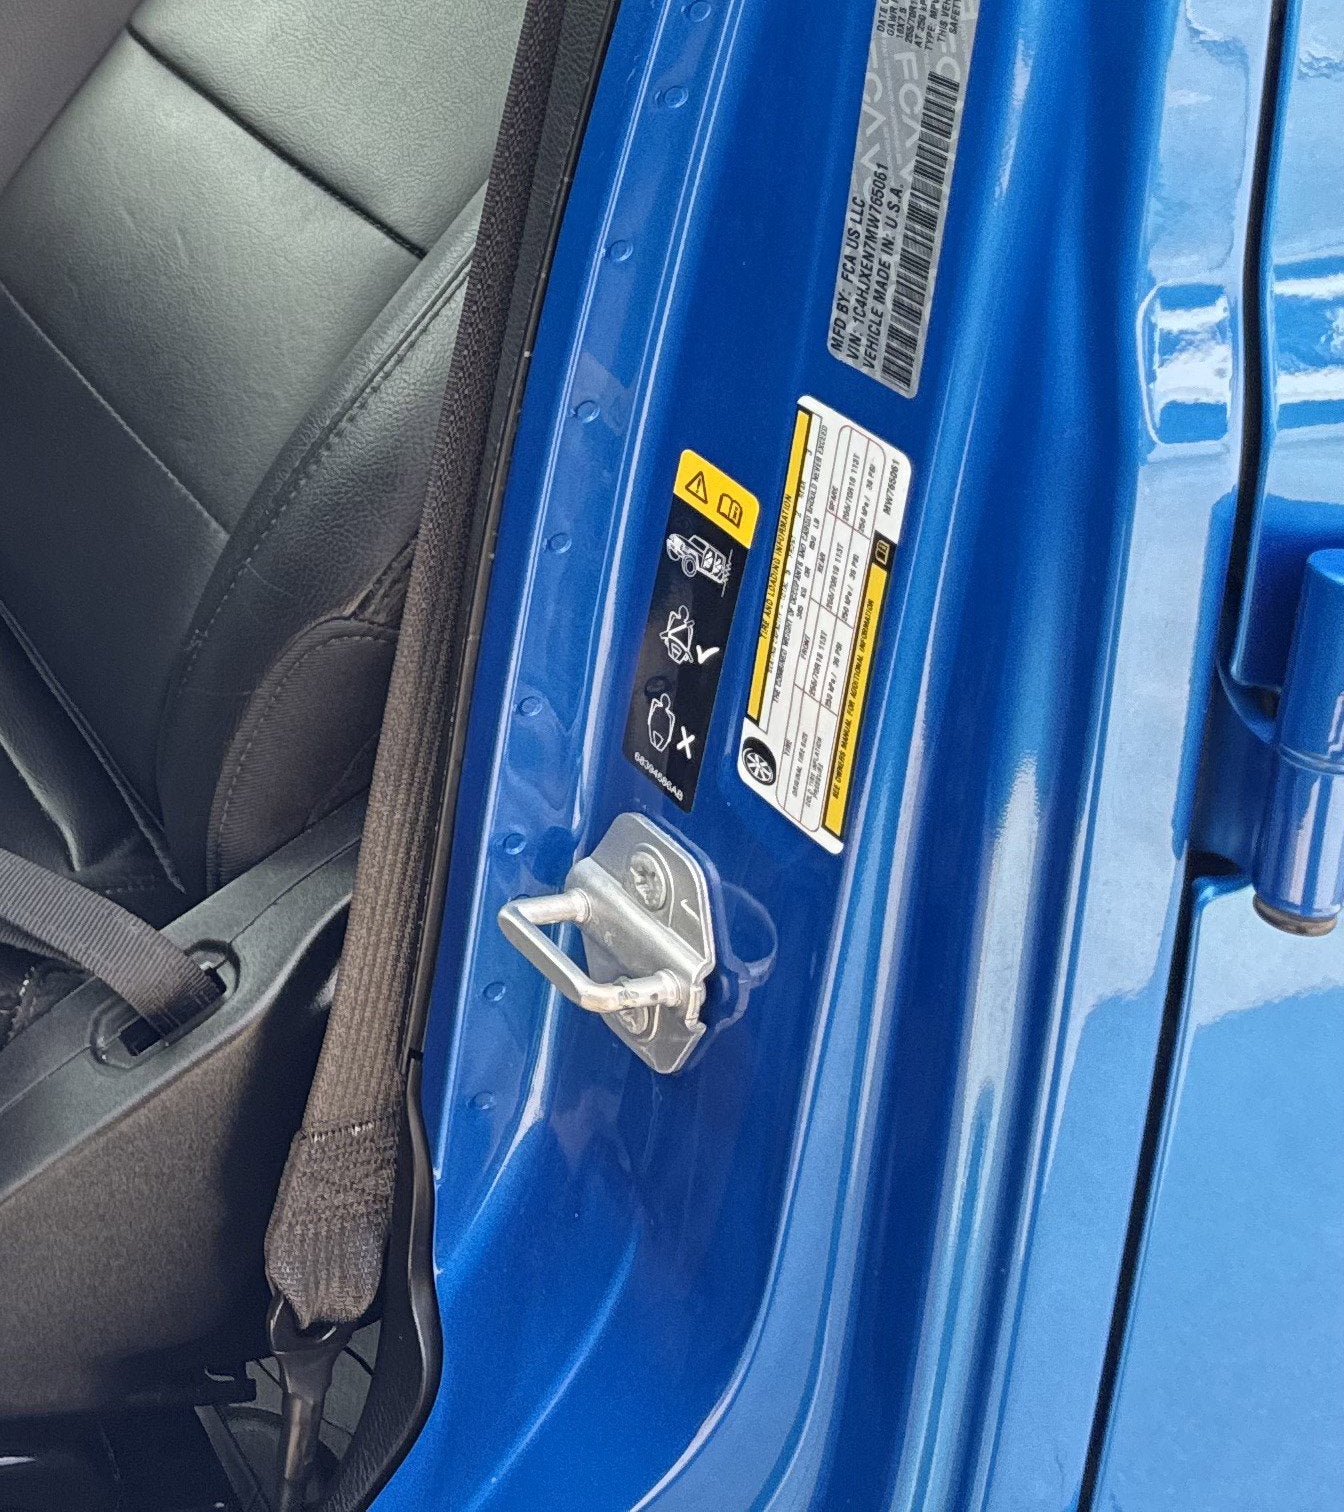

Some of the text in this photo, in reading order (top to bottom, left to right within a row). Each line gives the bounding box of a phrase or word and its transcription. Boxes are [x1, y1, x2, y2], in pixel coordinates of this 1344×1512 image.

[876, 6, 887, 32] DATE
[936, 19, 948, 43] THIS
[831, 195, 865, 353] MFD BY: FCA US LLC
[872, 256, 891, 305] MADE
[846, 326, 864, 363] VIN:
[862, 305, 883, 371] VEHICLE
[883, 457, 899, 515] MW765061
[774, 492, 791, 557] INFORMATION
[767, 556, 780, 597] LOADING
[763, 596, 773, 618] AND
[760, 618, 769, 640] TIRE
[800, 633, 810, 660] FRONT
[846, 699, 855, 717] FOR
[858, 597, 874, 653] INFORMATION
